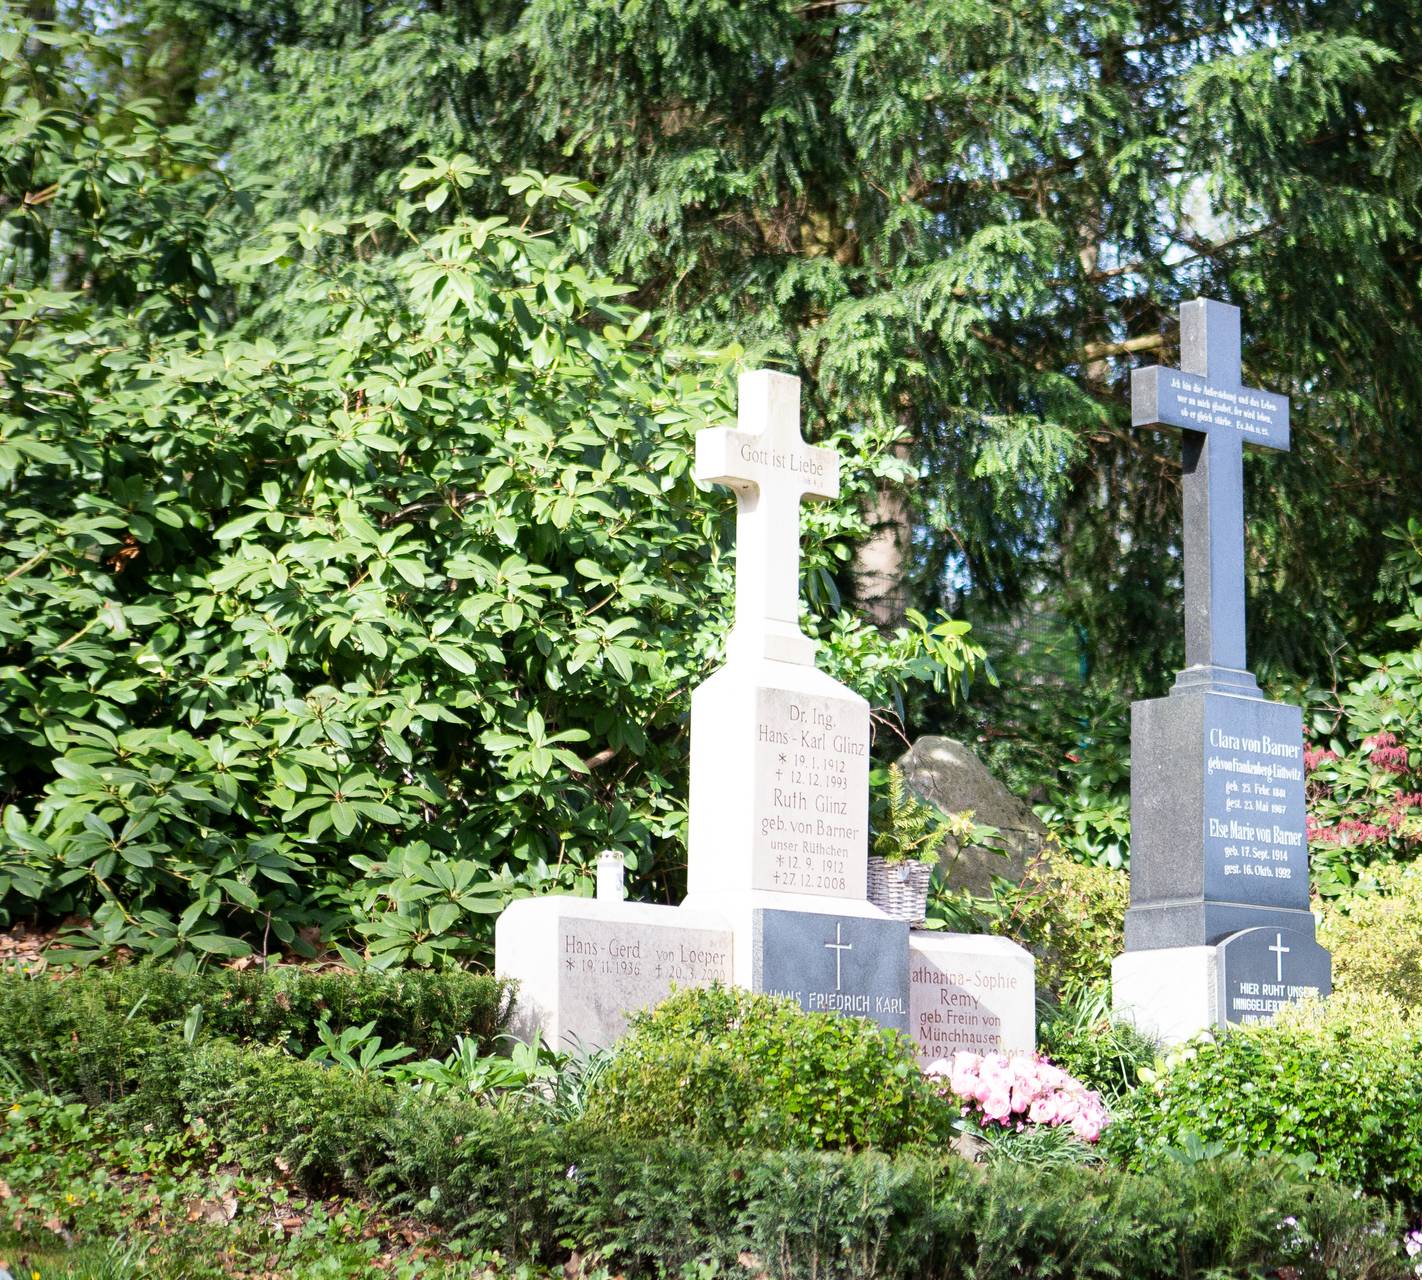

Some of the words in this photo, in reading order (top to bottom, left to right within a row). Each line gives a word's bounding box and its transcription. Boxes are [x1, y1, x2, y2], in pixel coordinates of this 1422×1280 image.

[741, 444, 767, 465] Gott
[772, 449, 785, 469] ist
[790, 454, 823, 475] Liebe
[790, 704, 807, 723] Dr.
[813, 708, 836, 731] Ing.
[834, 735, 865, 756] Glinz
[1210, 728, 1240, 750] Clara
[1242, 737, 1260, 753] von
[1262, 735, 1300, 759] Barner
[824, 759, 846, 773] 1912
[791, 771, 805, 784] 12.
[826, 776, 847, 790] 1993
[774, 788, 806, 810] Ruth
[815, 794, 847, 815] Glinz
[1256, 799, 1268, 812] Mai
[761, 815, 787, 836] geb.
[790, 821, 812, 835] von
[817, 819, 859, 840] Barner
[1209, 818, 1229, 838] Else
[1230, 820, 1255, 841] Marie
[1256, 827, 1271, 843] von
[1273, 825, 1302, 846] Barner
[770, 840, 798, 852] unser
[1224, 845, 1239, 858] geb.
[1241, 846, 1251, 857] 17.
[1252, 847, 1270, 861] Sept.
[1272, 849, 1288, 861] 1914
[822, 859, 844, 873] 1912
[1224, 864, 1241, 876] gest.
[1243, 864, 1253, 876] 16.
[1275, 867, 1291, 879] 1992
[816, 876, 846, 890] 2008
[656, 949, 675, 962] von
[680, 944, 726, 967] Loeper
[582, 959, 596, 973] 19.
[615, 961, 640, 976] 1936
[912, 967, 1017, 990] atharina-Sophie
[940, 988, 980, 1010] Remy
[1240, 982, 1259, 995] HIER
[1263, 984, 1286, 997] RUHT
[808, 991, 870, 1012] FRIEDRICH
[875, 995, 906, 1014] KARL
[1233, 997, 1285, 1012] INNIGGELIEBT
[920, 1009, 943, 1026] geb.
[947, 1009, 978, 1026] Freiin
[982, 1015, 1001, 1026] von
[920, 1026, 1002, 1045] Münchhausen
